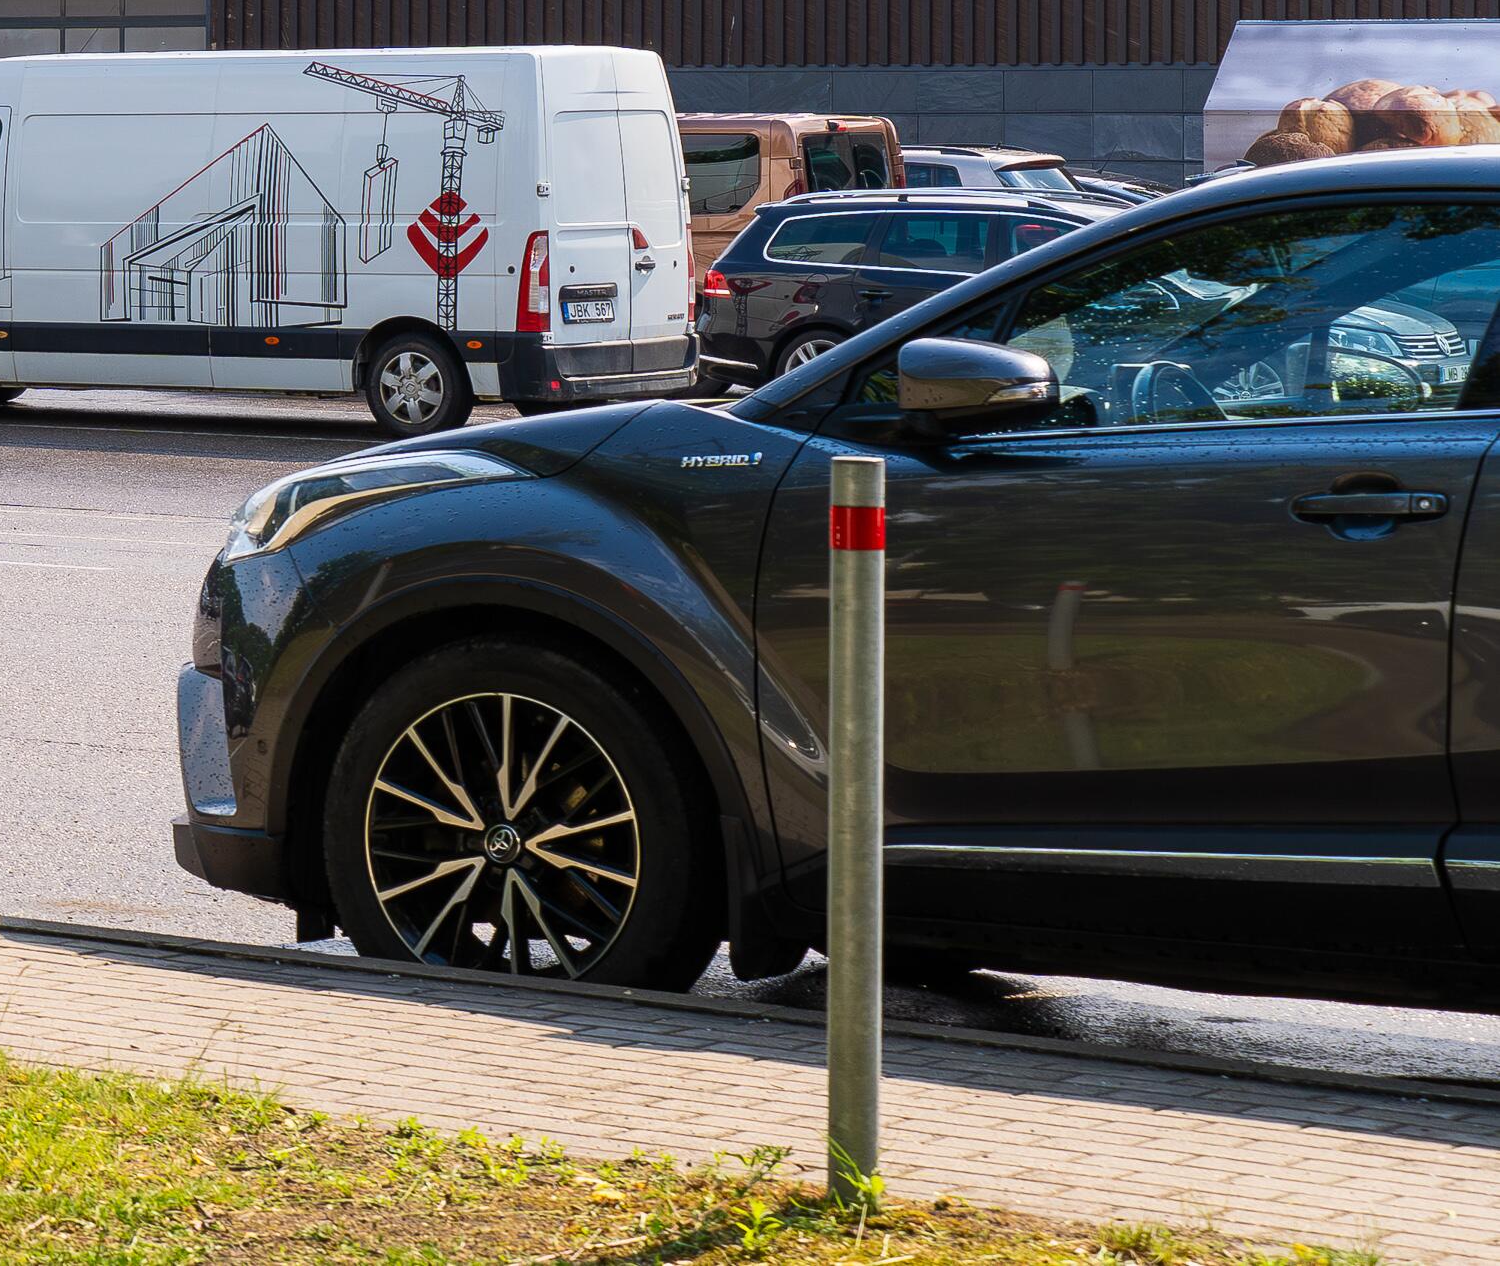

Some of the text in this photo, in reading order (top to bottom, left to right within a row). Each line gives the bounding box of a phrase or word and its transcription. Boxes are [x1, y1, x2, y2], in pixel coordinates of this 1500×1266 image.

[570, 302, 611, 318] JBK 567
[680, 454, 750, 468] HYBRID
